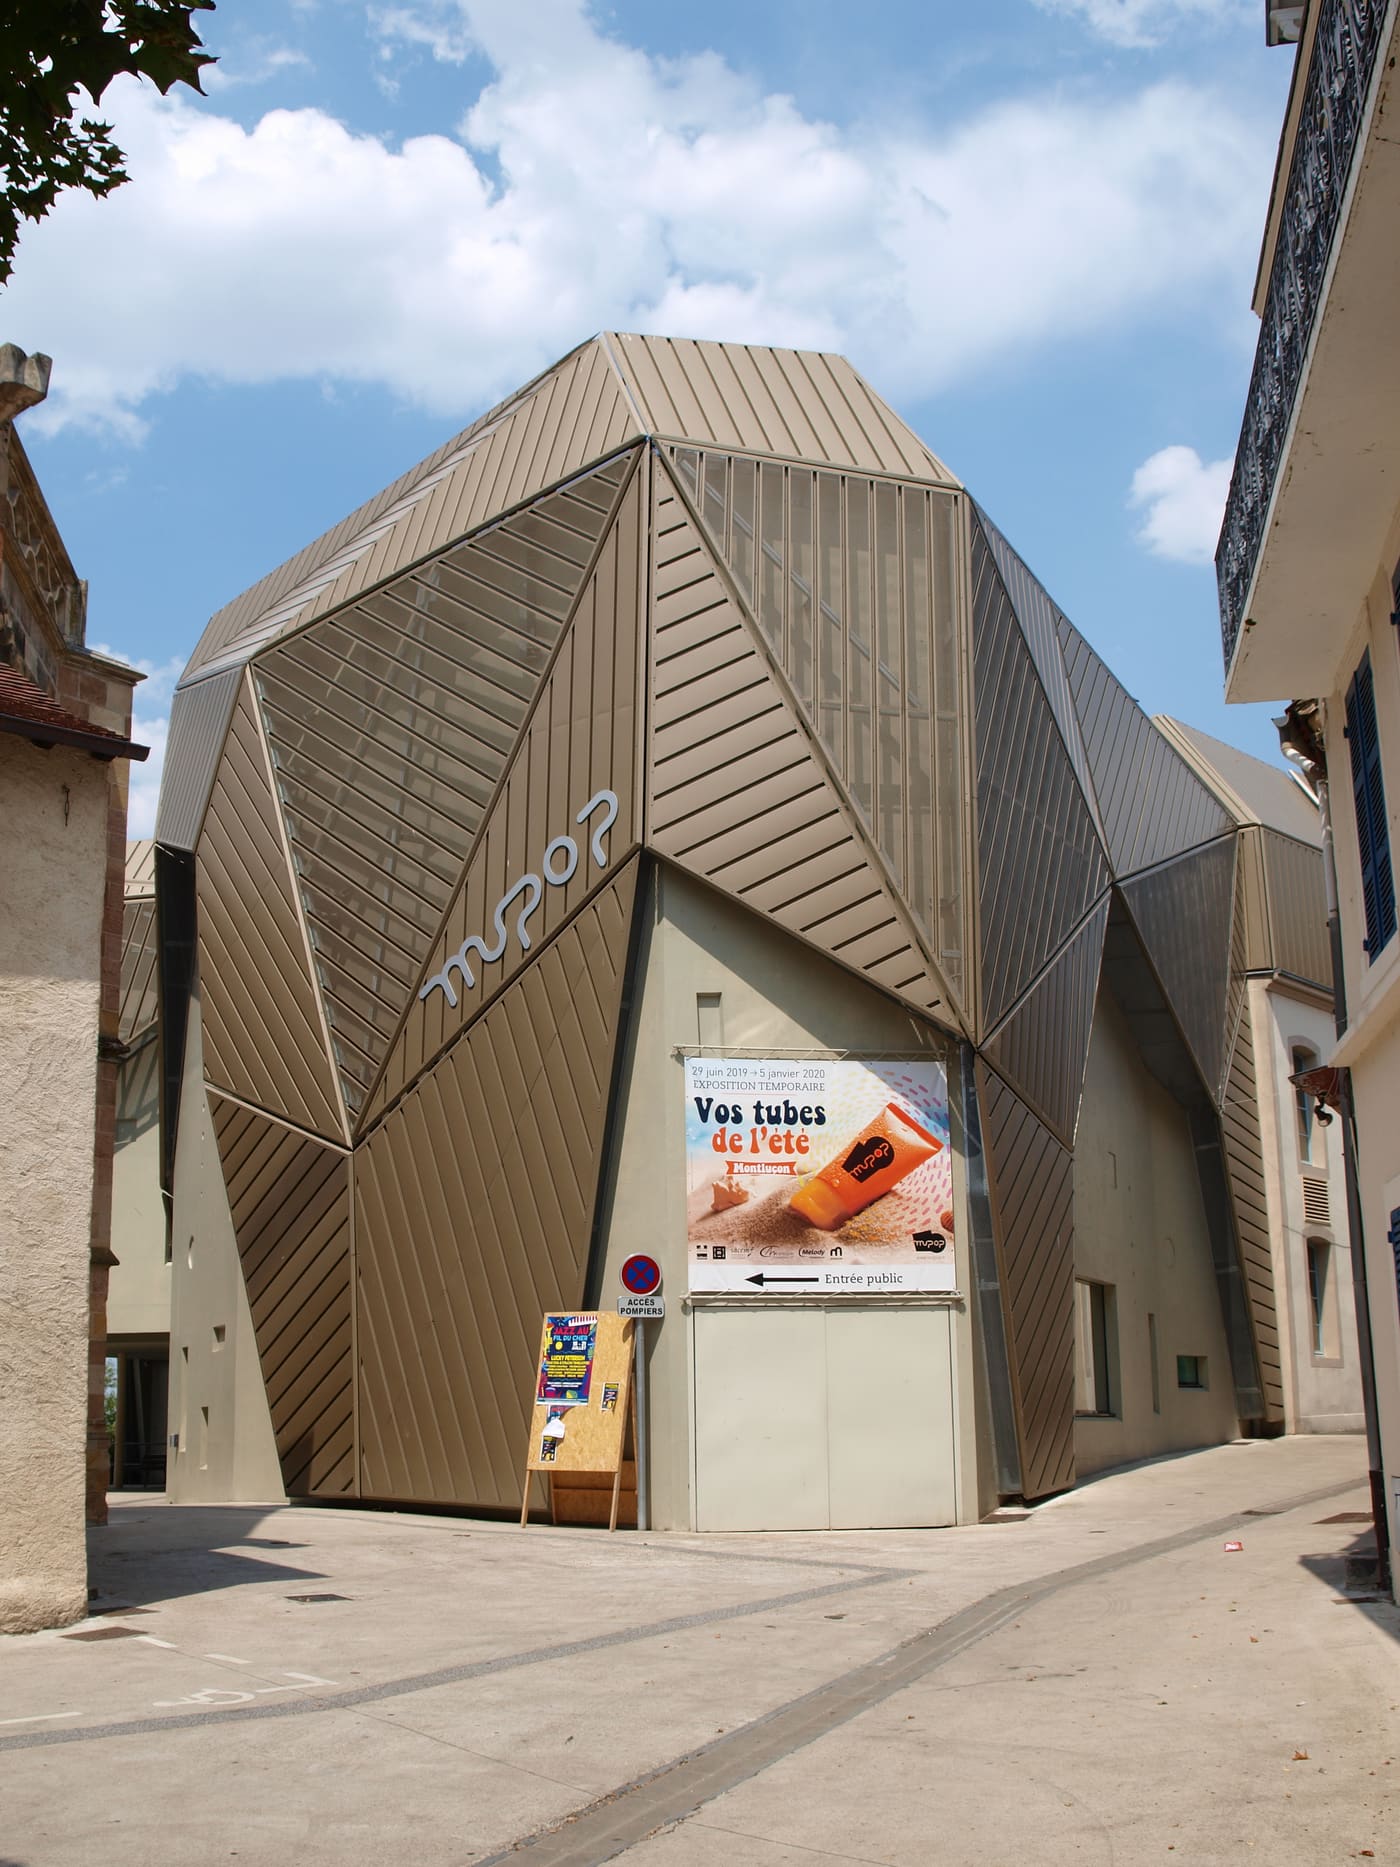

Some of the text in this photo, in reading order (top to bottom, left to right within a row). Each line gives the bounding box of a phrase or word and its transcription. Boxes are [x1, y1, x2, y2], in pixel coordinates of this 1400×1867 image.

[692, 1066, 825, 1080] 29 juin 2019 5 janvier 2020
[693, 1080, 825, 1092] EXPOSITION TEMPORAIRE
[694, 1097, 826, 1126] Vos tubes
[711, 1126, 810, 1155] de l'été
[733, 1162, 791, 1175] Montluçon
[825, 1272, 903, 1290] Entrée public
[620, 1307, 663, 1315] POMPIERS
[553, 1327, 589, 1335] JAZZ AU
